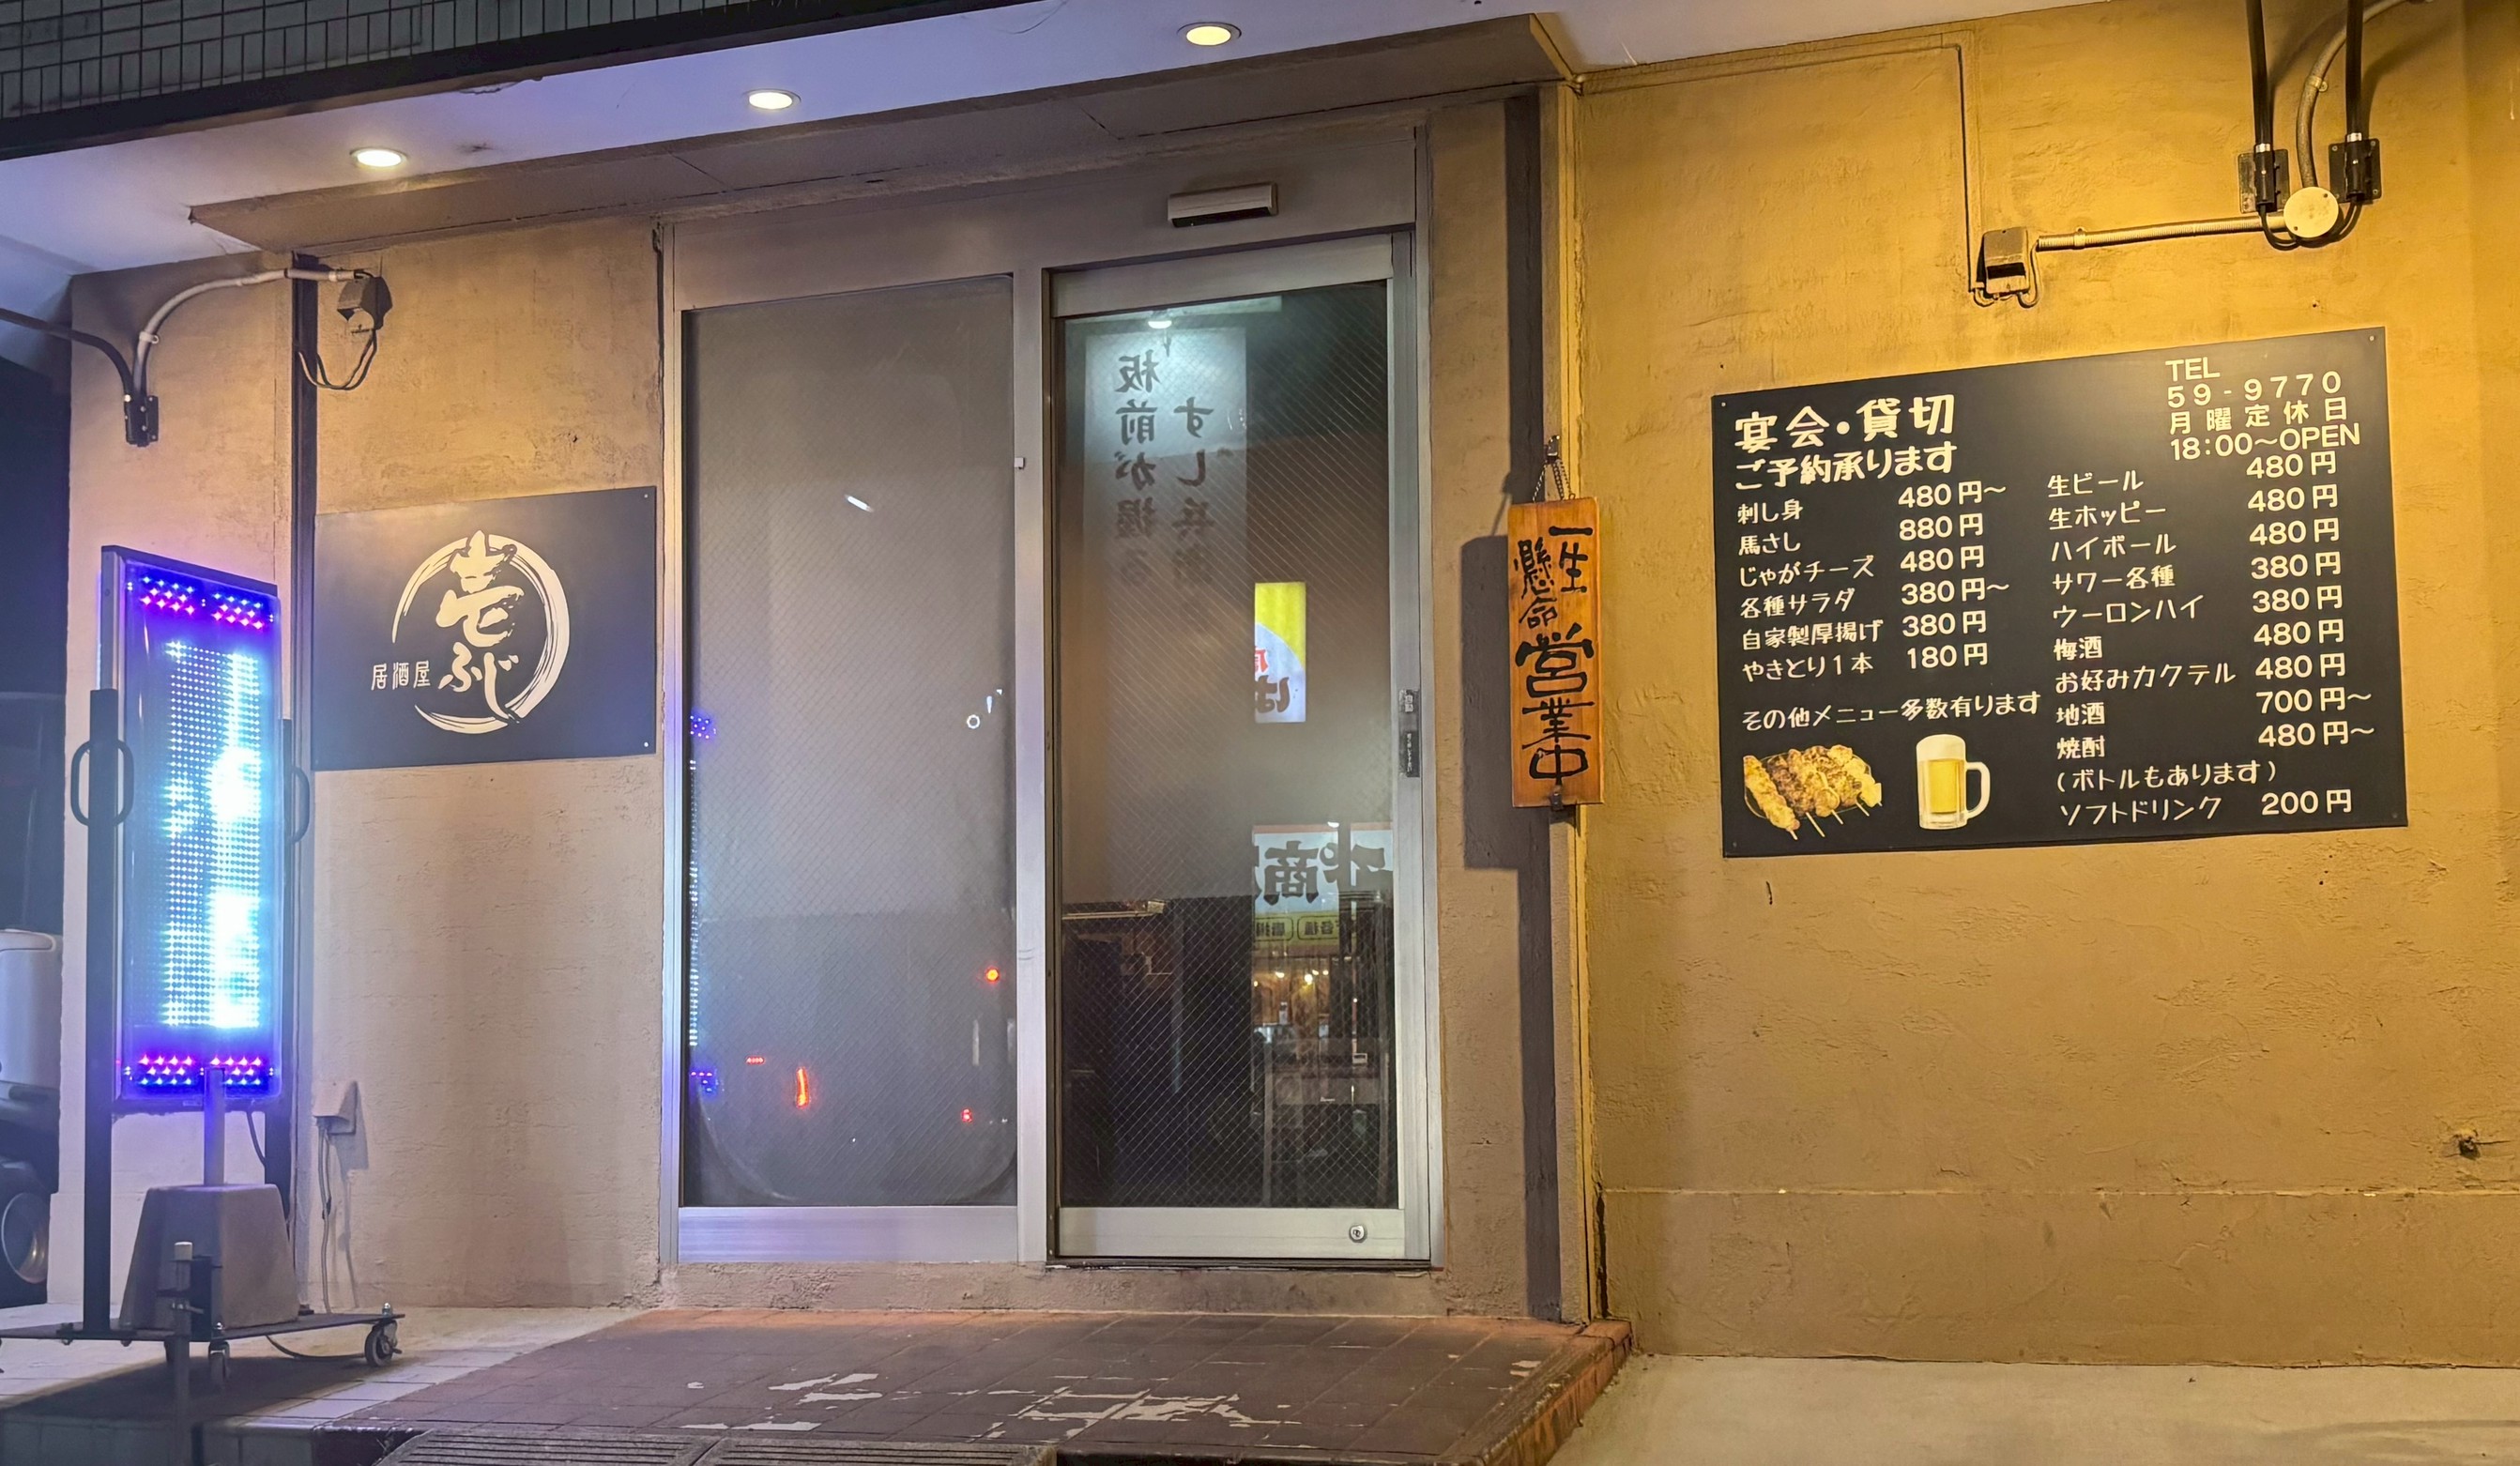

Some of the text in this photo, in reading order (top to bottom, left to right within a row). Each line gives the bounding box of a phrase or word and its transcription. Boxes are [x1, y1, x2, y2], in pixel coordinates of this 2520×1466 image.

[2165, 357, 2221, 382] TEL
[2170, 396, 2347, 435] 月曜定休日
[1734, 440, 1958, 490] ご予約承ります
[2047, 469, 2145, 498] 生ビール
[1737, 497, 1804, 526] 刺し身
[2048, 500, 2166, 530] 生ホッピー
[1738, 531, 1801, 557] 馬さし
[2051, 533, 2176, 562] ハイボール
[1740, 554, 1874, 588] じゃがチーズ
[2052, 564, 2176, 596] サワー各種
[1740, 587, 1856, 619] 各種サラダ
[2053, 594, 2204, 629] ウーロンハイ
[1742, 618, 1884, 650] 自家製厚揚げ
[2053, 635, 2103, 662] 梅酒
[371, 660, 431, 691] 居酒屋
[2054, 662, 2237, 694] お好みカクテル
[1515, 623, 1595, 786] 営業中
[1742, 690, 2041, 731] その他メニュー多数有ります
[2055, 701, 2105, 726] 地酒
[2056, 734, 2106, 760] 焼酎
[2060, 795, 2222, 827] ソフトドリンク
